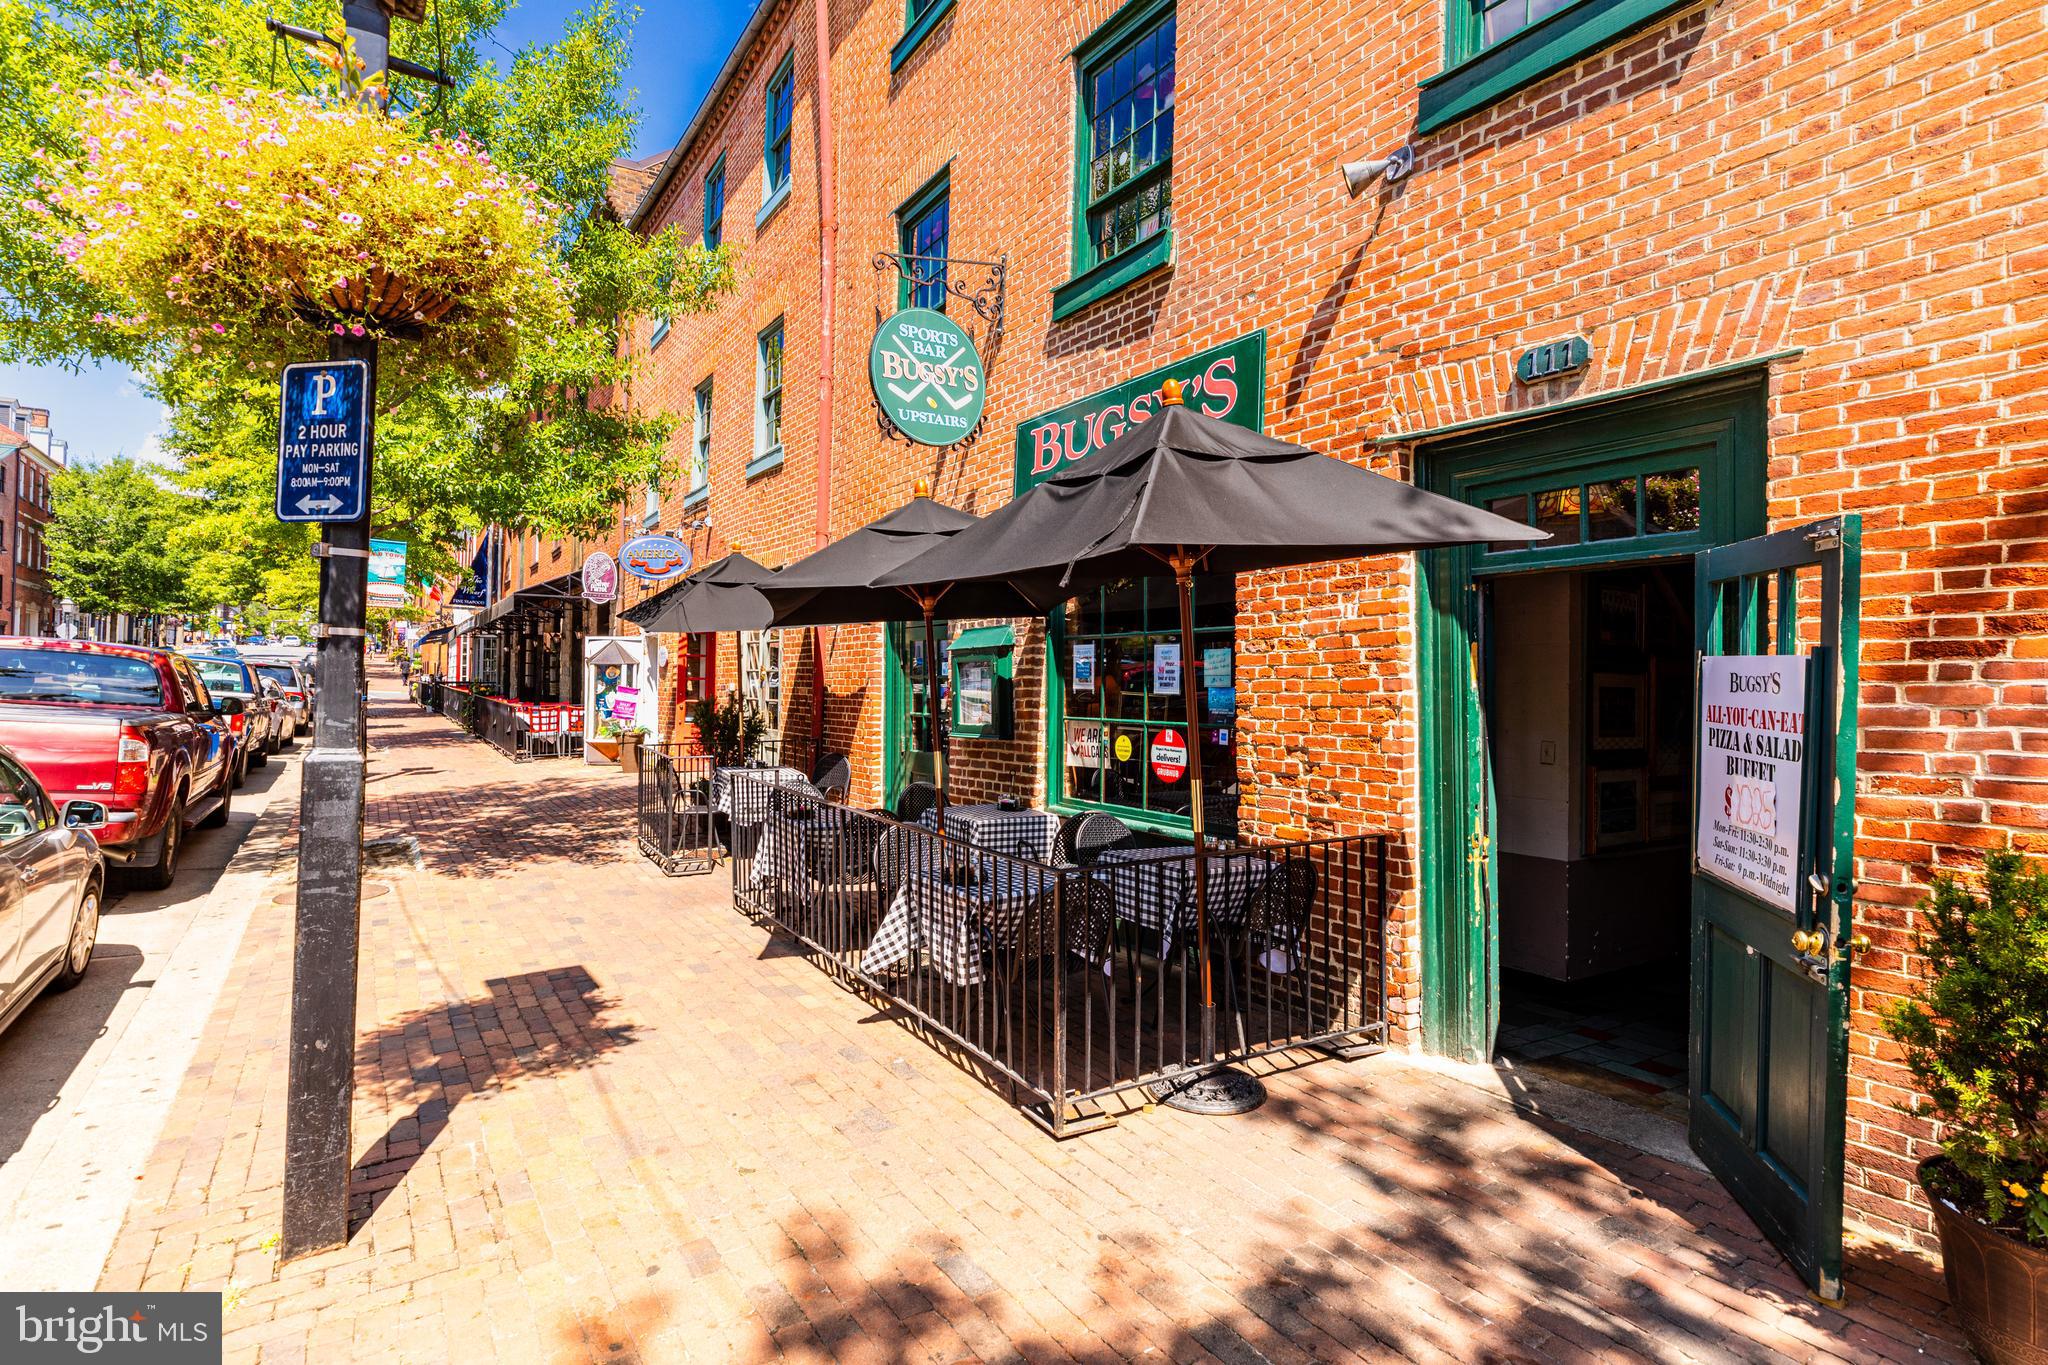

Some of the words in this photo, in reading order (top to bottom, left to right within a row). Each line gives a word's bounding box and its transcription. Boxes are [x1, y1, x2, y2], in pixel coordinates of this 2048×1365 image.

[899, 323, 959, 347] SPORTS
[912, 340, 947, 359] BAR
[1527, 339, 1578, 377] 111
[880, 350, 979, 392] BUGSY'S
[311, 374, 337, 416] P
[898, 408, 968, 429] UPSTAIRS
[1030, 355, 1238, 476] BUGS'S
[298, 425, 306, 440] 2
[310, 423, 347, 440] HOUR
[285, 444, 308, 458] PAY
[311, 442, 359, 458] PARKING
[1729, 671, 1781, 695] BUGSY'S
[1706, 704, 1805, 735] ALL-YOU-CAN-EAT
[1074, 727, 1087, 743] WE
[1087, 728, 1102, 744] ARE
[1708, 726, 1740, 752] PIZZA
[1743, 732, 1753, 754] &
[1756, 734, 1802, 763] SALAD
[1156, 752, 1181, 764] delivers!
[1726, 755, 1776, 783] BUFFET
[92, 782, 113, 790] V8
[1713, 819, 1739, 839] Mon-Fri:
[1740, 829, 1773, 852] 11:30-2:30
[1774, 844, 1790, 858] p.m.
[1712, 836, 1738, 855] Sat-Sun:
[1739, 846, 1772, 870] 11:30-3:30
[1772, 861, 1788, 876] p.m.
[1714, 853, 1736, 872] Fri-Sat:
[1737, 862, 1742, 874] 9
